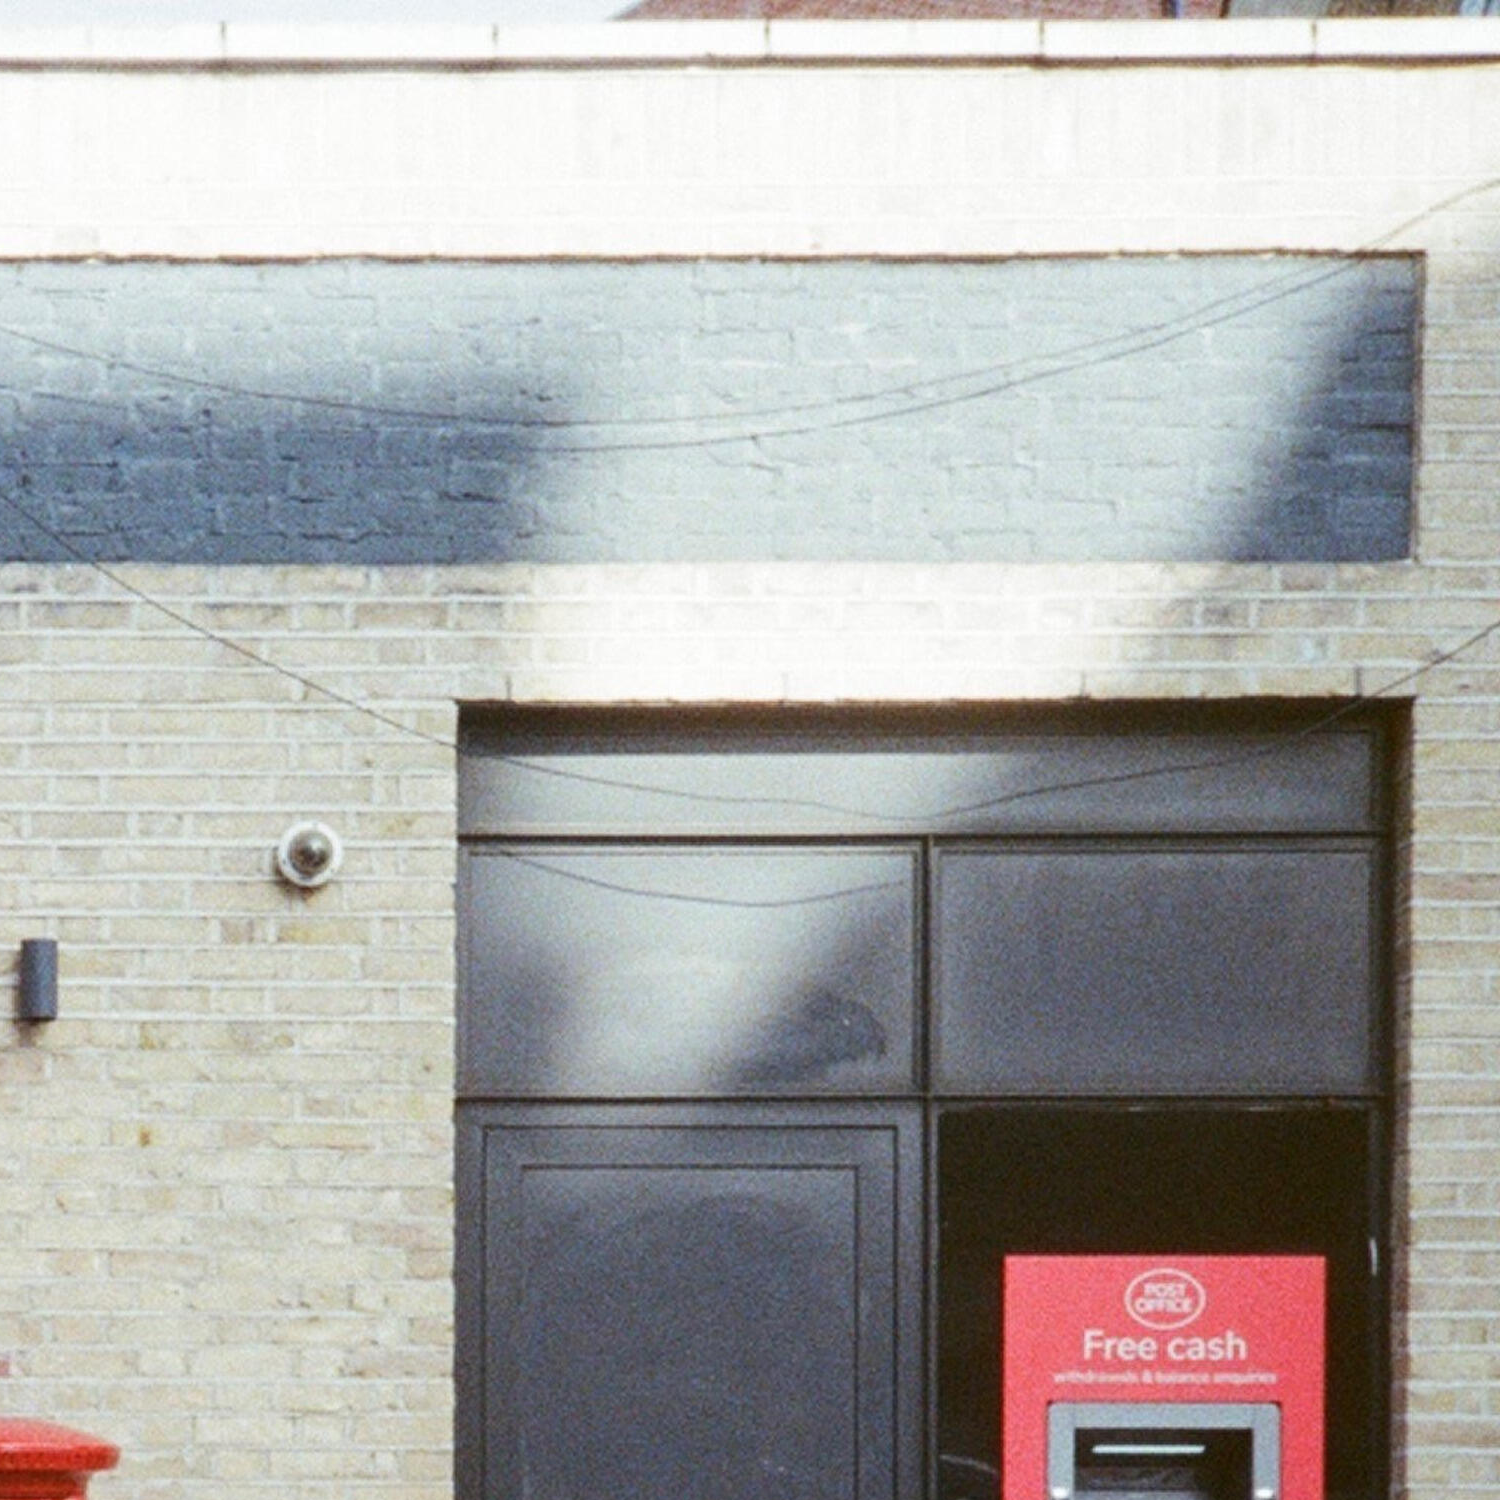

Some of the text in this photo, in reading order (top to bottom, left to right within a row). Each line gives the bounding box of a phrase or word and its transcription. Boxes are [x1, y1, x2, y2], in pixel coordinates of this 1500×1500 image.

[1143, 1282, 1187, 1298] POST
[1134, 1298, 1193, 1314] OFFICE
[1082, 1328, 1249, 1361] Free cash
